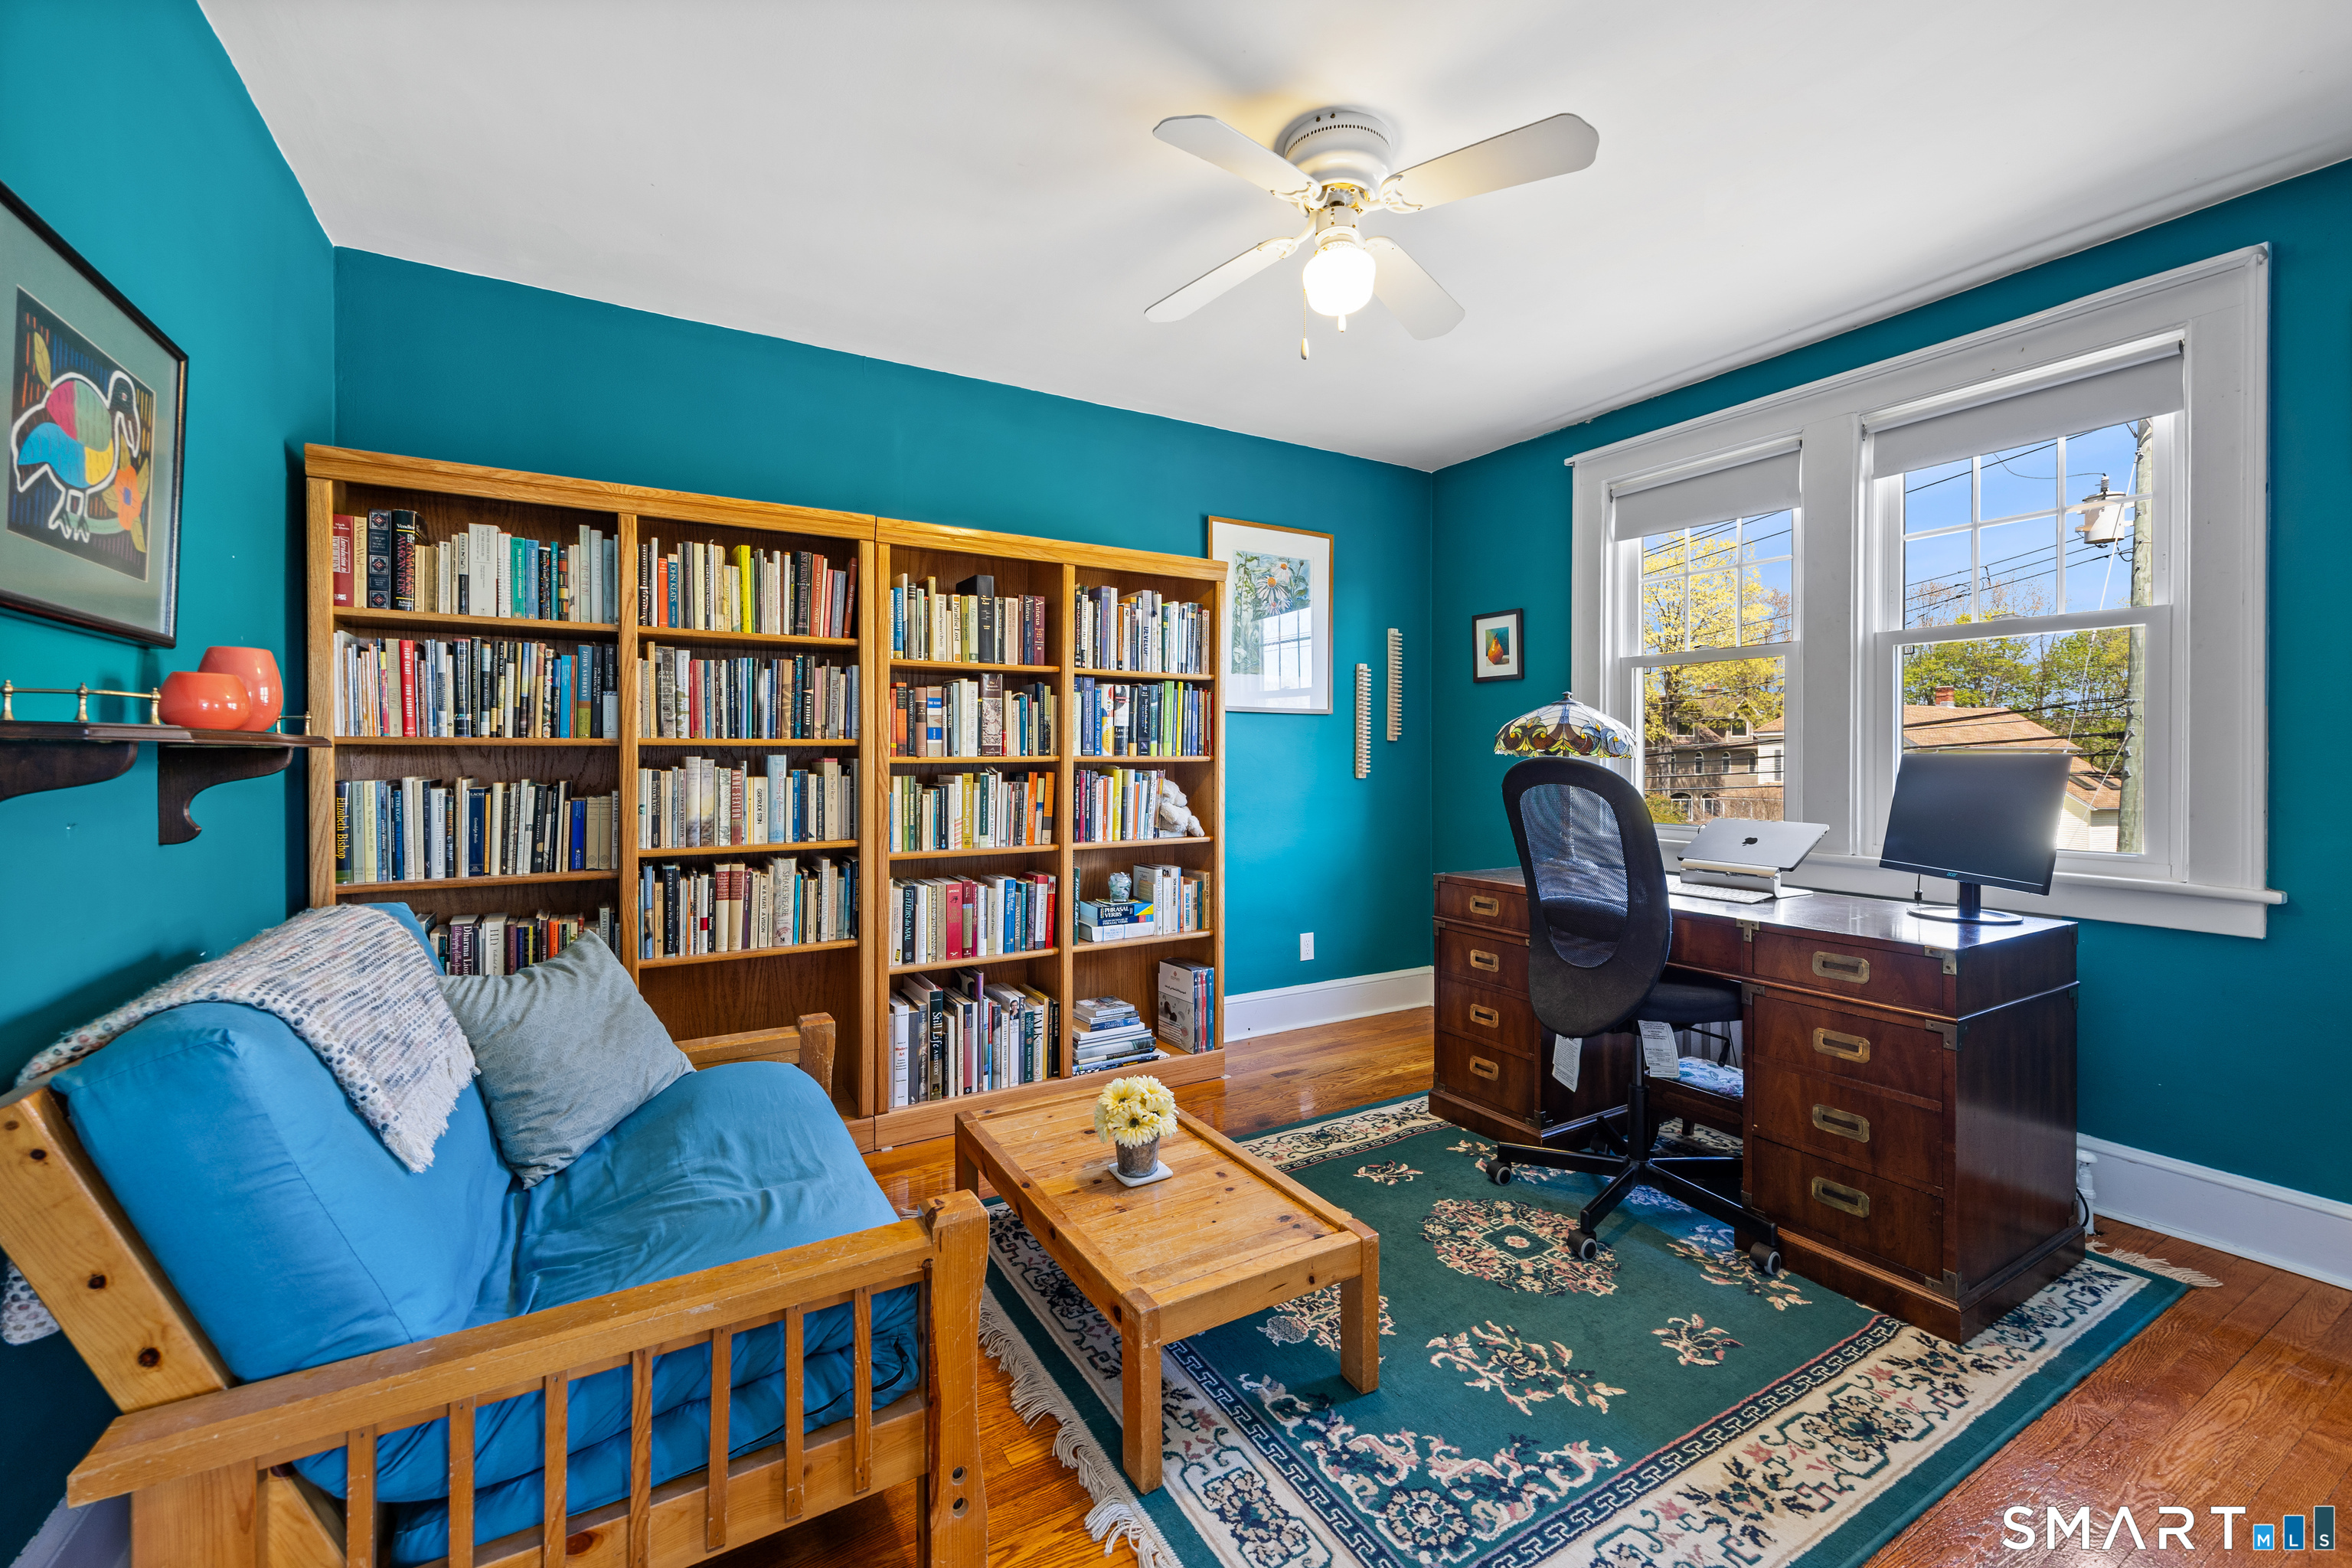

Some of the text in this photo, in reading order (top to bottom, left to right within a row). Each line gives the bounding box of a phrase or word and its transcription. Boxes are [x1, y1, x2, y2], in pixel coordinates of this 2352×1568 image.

[355, 522, 364, 548] Western
[340, 537, 348, 567] Introduction
[355, 548, 364, 566] Wind
[397, 534, 406, 596] AMERICAN POETRY
[460, 551, 466, 570] 35
[405, 543, 415, 596] CONTEMPORARY
[668, 564, 677, 581] JOHN
[731, 770, 741, 818] ANNE SEXTON
[335, 797, 350, 859] Elizabeth Bishop
[462, 926, 472, 975] Dharma Lion
[932, 1011, 942, 1029] Still
[1034, 1010, 1043, 1040] TALK
[929, 1030, 942, 1048] Life
